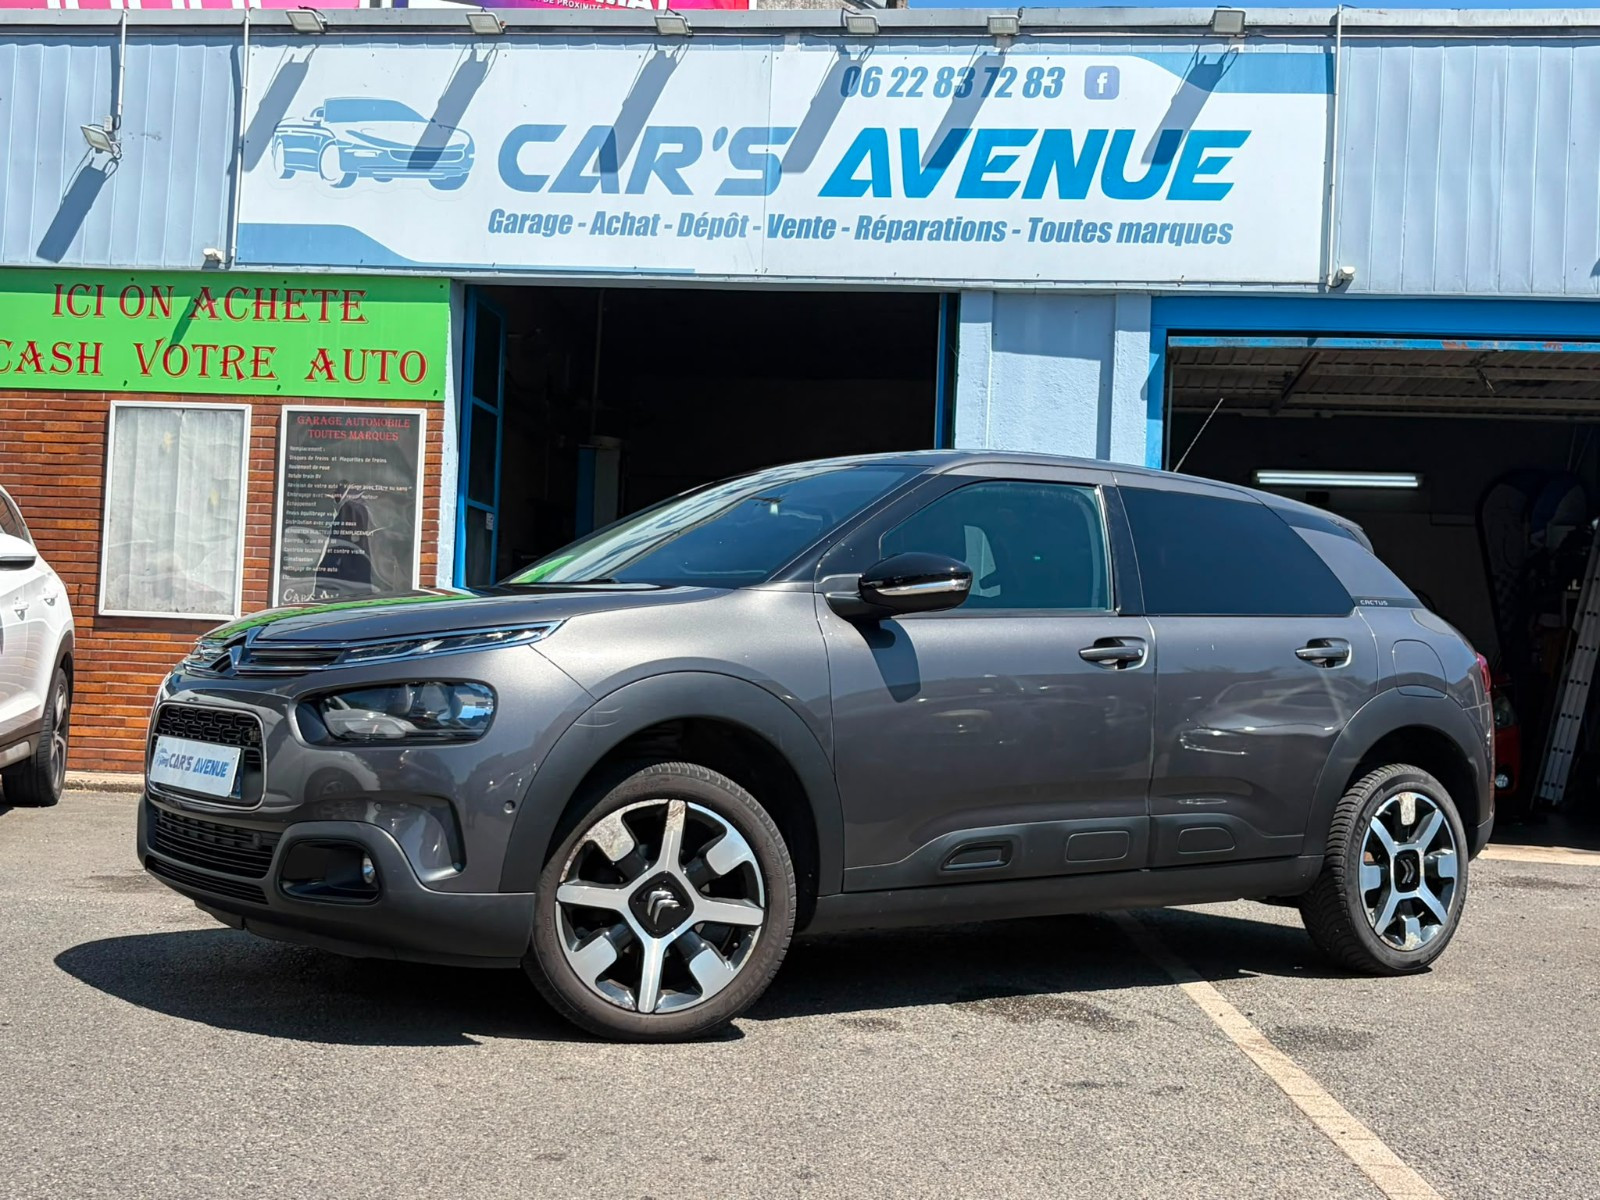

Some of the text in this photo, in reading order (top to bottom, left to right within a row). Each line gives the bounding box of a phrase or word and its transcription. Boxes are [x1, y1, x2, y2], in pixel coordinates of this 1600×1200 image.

[840, 66, 1066, 99] 06 22 83 72 83
[498, 124, 1252, 201] CAR'S AVENUE
[488, 209, 573, 238] Garage
[589, 210, 661, 237] Achat
[677, 211, 750, 240] Dépôt
[767, 214, 837, 240] Vente
[854, 215, 1008, 243] Réparations
[1027, 217, 1113, 243] Toutes
[1116, 221, 1234, 247] marques
[52, 283, 369, 324] ICI ON ACHETE
[0, 337, 428, 384] CASH VOTRE AUTO
[297, 416, 411, 429] GARAGE AUTOMOBILE
[307, 429, 399, 441] TOUTES MARQUES
[169, 753, 229, 778] CAR'S AVENUE
